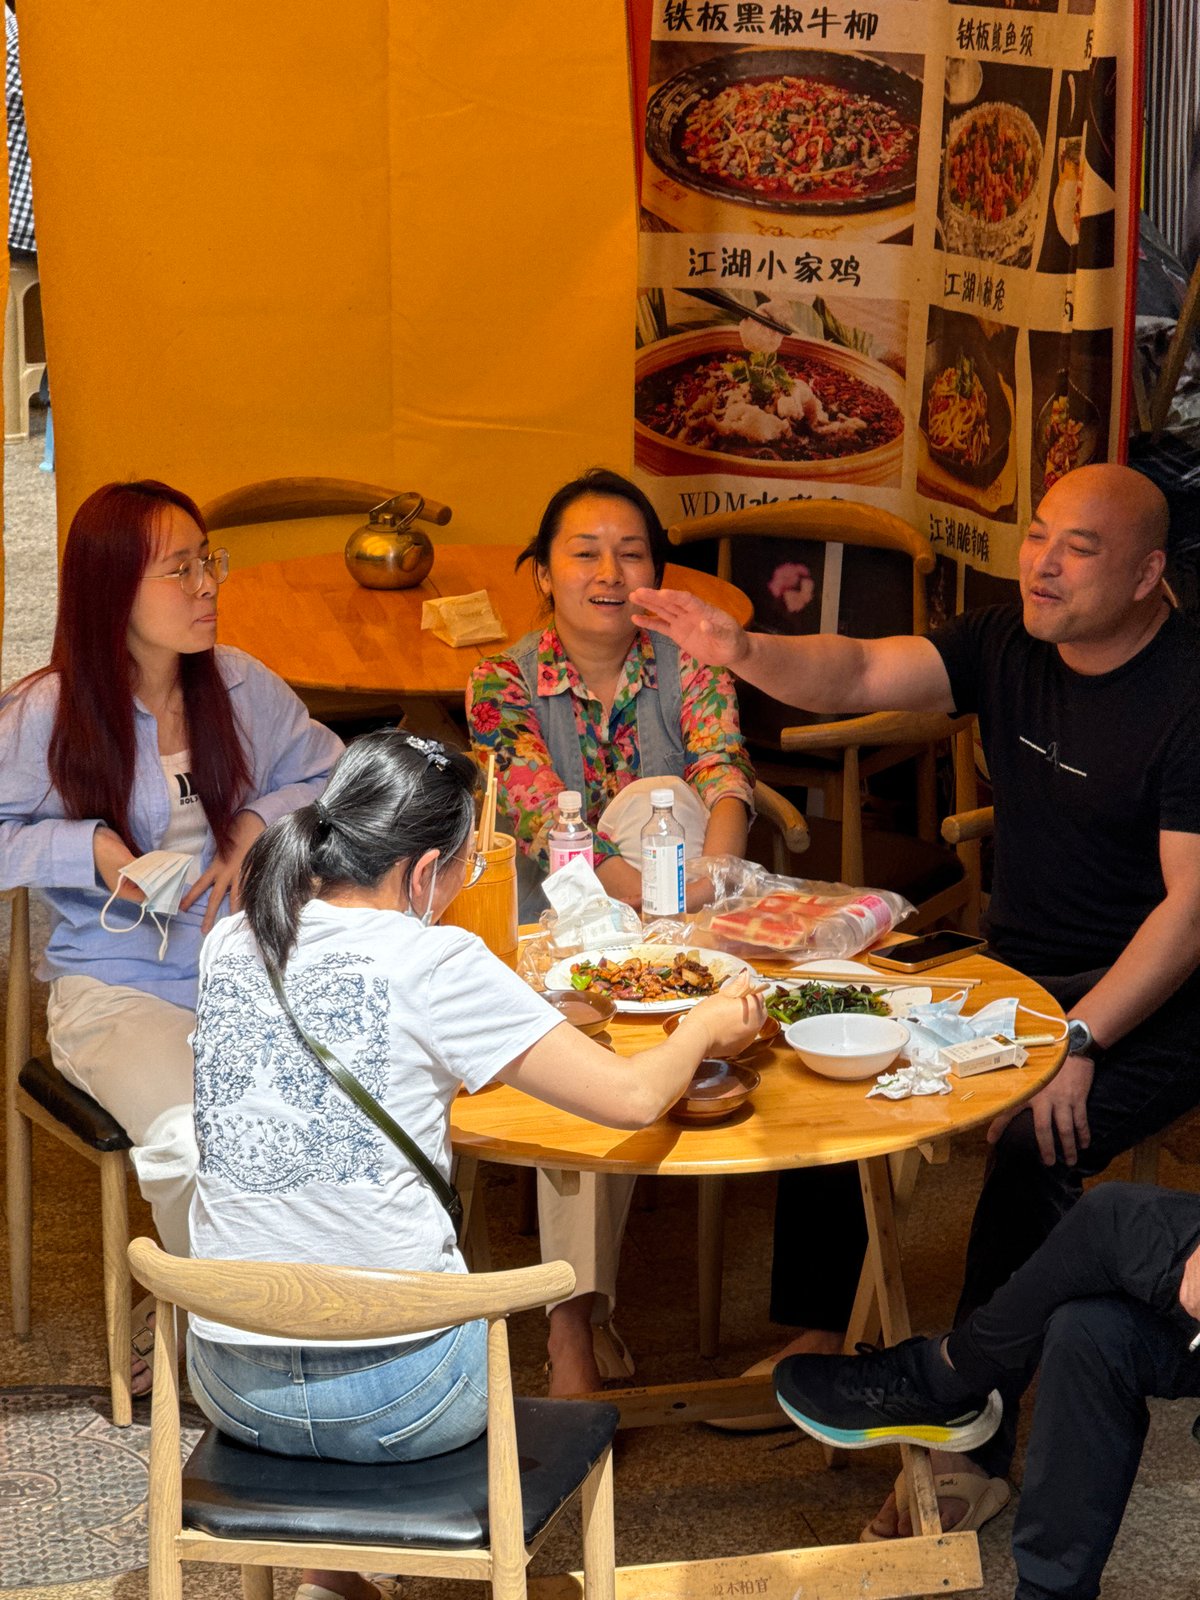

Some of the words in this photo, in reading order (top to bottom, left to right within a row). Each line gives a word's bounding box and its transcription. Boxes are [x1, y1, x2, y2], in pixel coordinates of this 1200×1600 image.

[662, 0, 879, 41] 铁板黑椒牛柳
[688, 247, 861, 287] 江湖小家鸡
